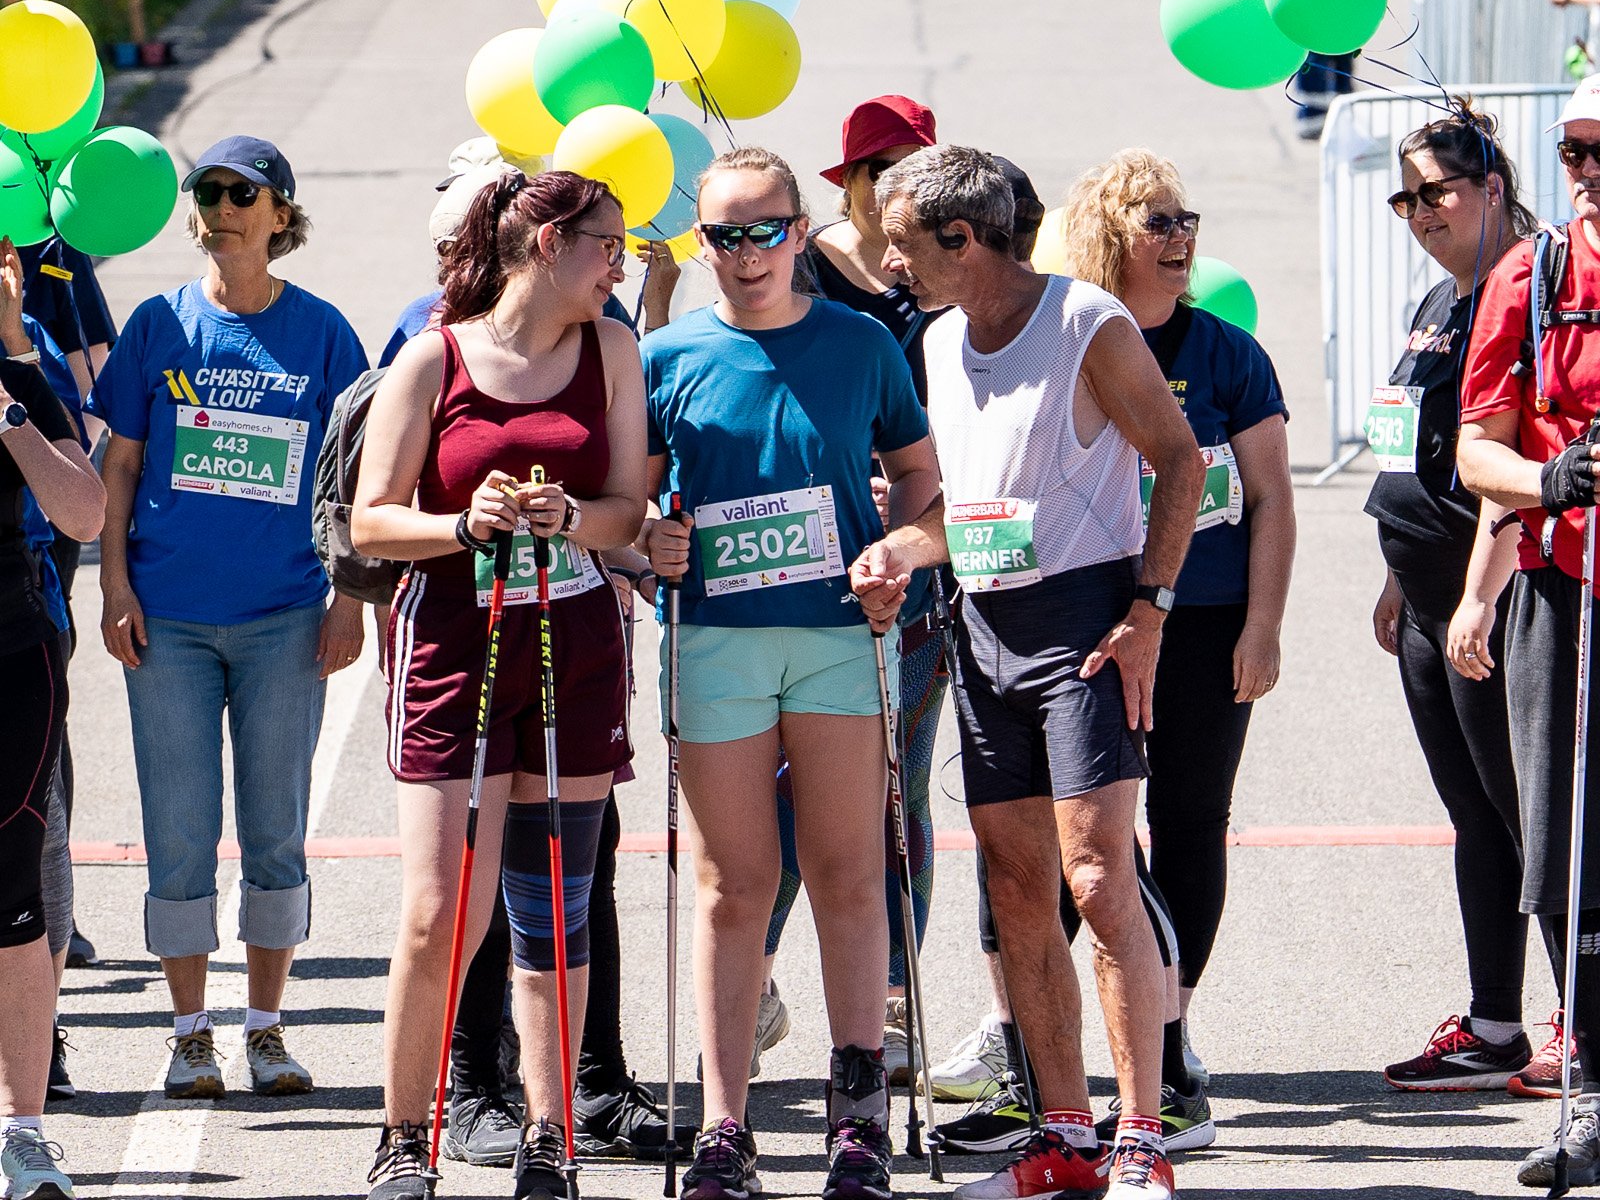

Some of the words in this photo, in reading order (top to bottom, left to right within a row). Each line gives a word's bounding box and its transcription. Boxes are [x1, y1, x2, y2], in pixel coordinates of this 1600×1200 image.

[195, 368, 310, 394] CHÄSITZER
[207, 388, 264, 409] LOUF
[211, 419, 273, 434] easyhomes.ch
[1367, 415, 1404, 447] 2503
[212, 435, 249, 455] 443
[183, 453, 275, 483] CAROLA
[240, 486, 272, 498] valiant
[722, 497, 789, 521] valiant
[715, 524, 808, 568] 2502
[964, 526, 994, 546] 937
[951, 548, 1029, 572] WERNER
[553, 582, 581, 595] valiant
[488, 629, 500, 679] LEKI
[540, 619, 552, 668] LEKI
[476, 682, 488, 732] LEKI
